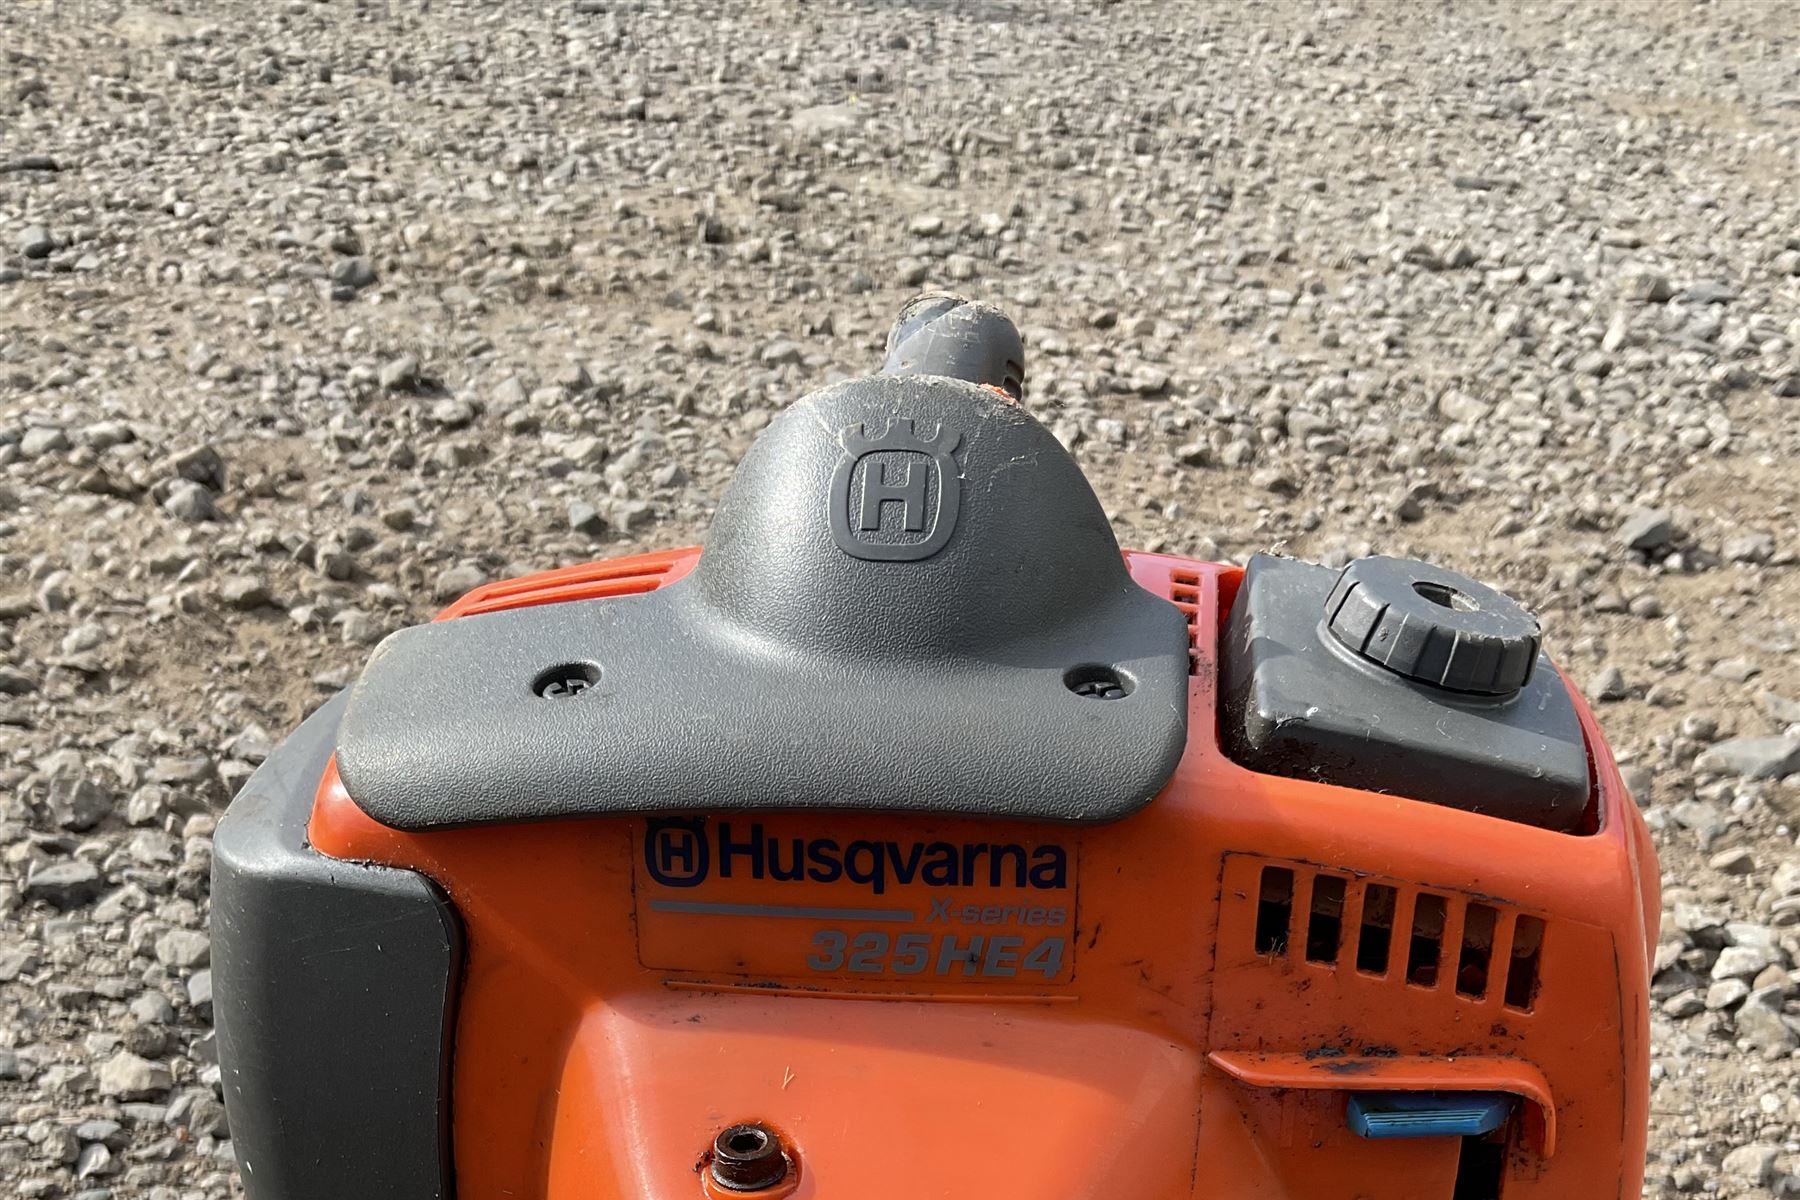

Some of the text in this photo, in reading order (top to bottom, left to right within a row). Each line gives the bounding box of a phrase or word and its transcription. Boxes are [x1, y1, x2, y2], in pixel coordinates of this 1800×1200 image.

[860, 462, 929, 532] H
[660, 833, 694, 872] H
[718, 821, 1067, 895] Husqvarna
[924, 895, 1066, 926] X-series
[806, 930, 1066, 979] 325HE4
